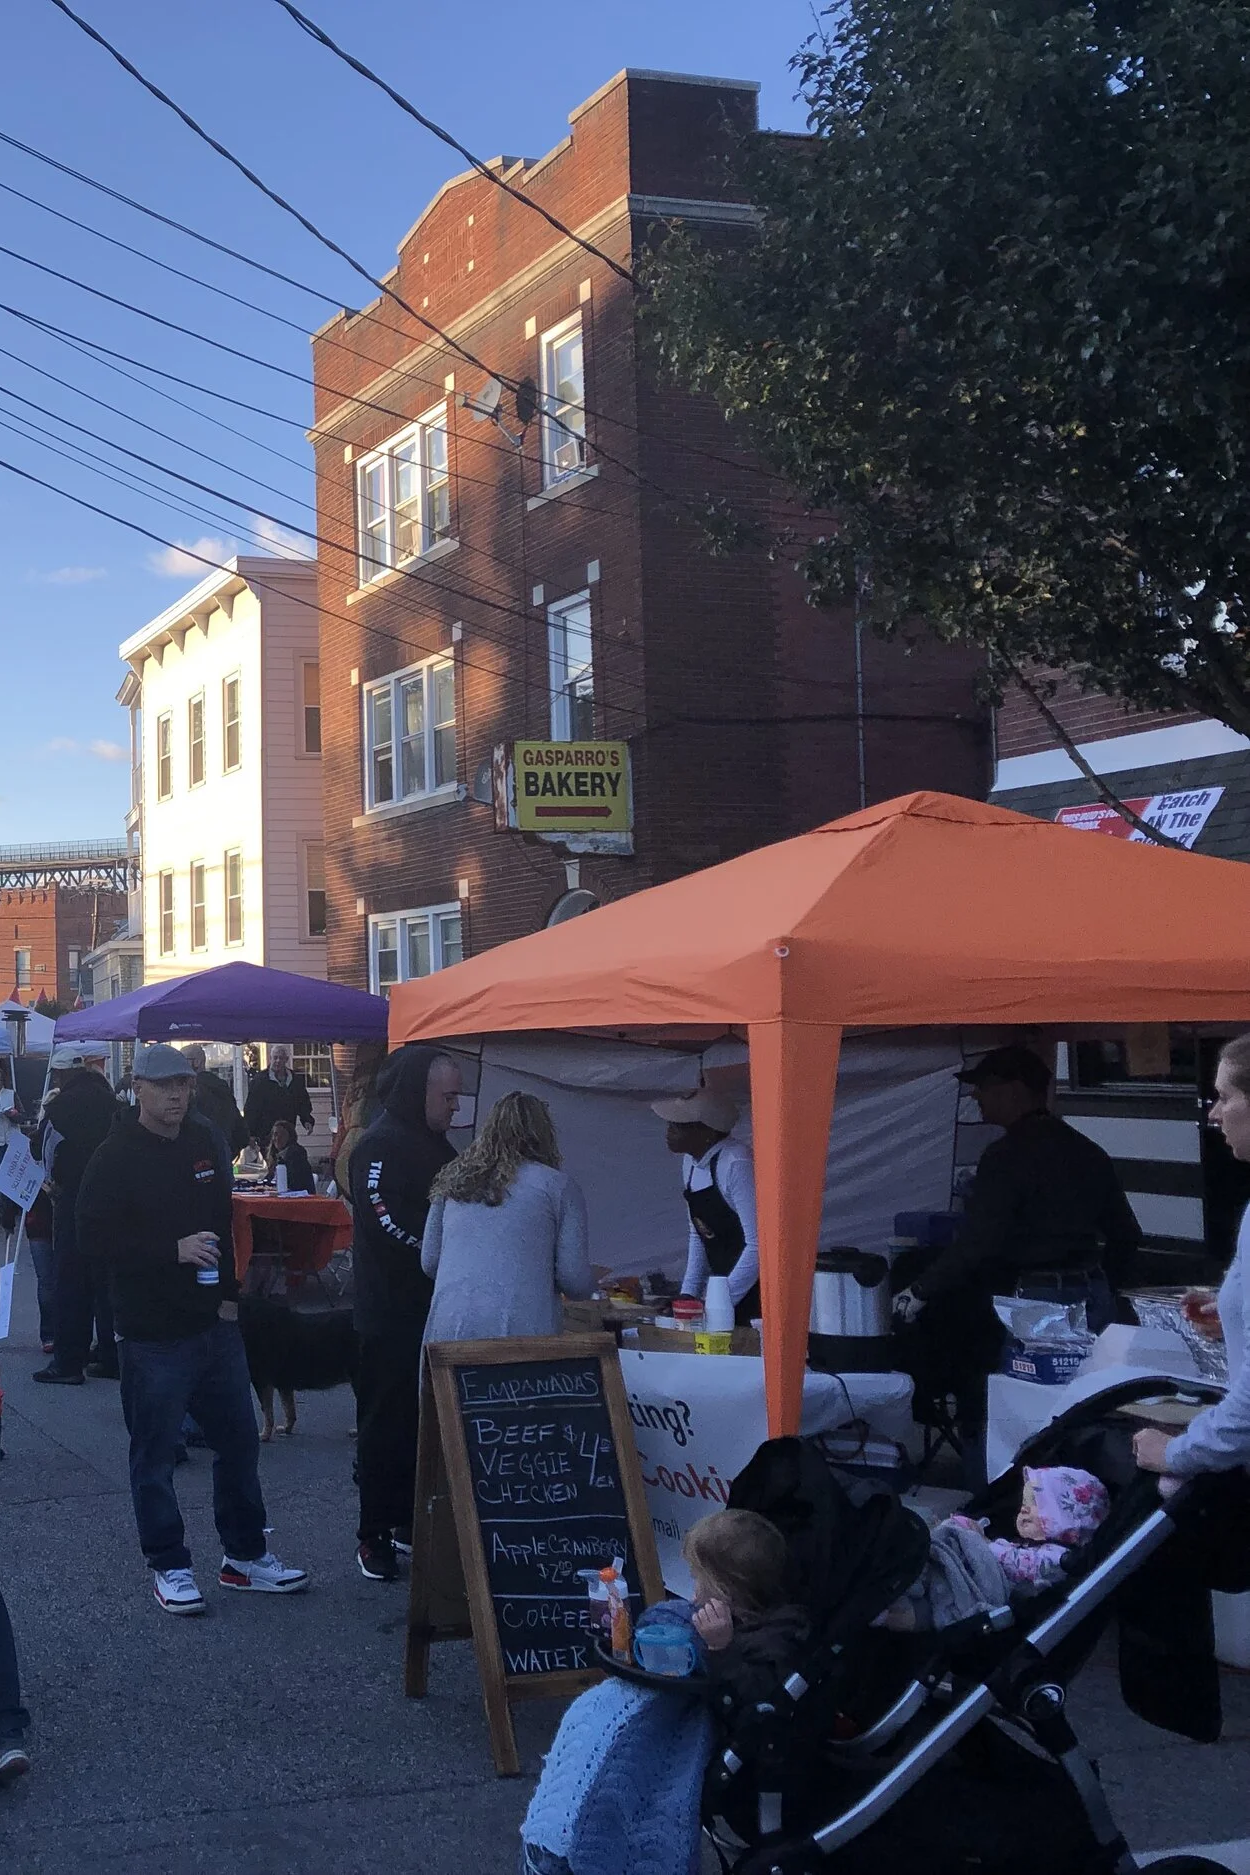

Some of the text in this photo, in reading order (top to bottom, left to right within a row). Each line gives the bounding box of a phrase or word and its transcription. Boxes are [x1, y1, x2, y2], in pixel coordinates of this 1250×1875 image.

[523, 749, 620, 766] GASPARRO'S
[524, 772, 622, 796] BAKERY
[1157, 791, 1211, 811] Catch
[1169, 811, 1203, 829] The
[367, 1161, 383, 1189] THE
[1014, 1360, 1035, 1373] 51215
[1052, 1357, 1080, 1367] 51215
[461, 1371, 599, 1405] EMPANADAS
[471, 1419, 556, 1444] BEEF
[478, 1448, 572, 1480] VEGGIE
[477, 1479, 578, 1504] CHICKEN
[506, 1645, 588, 1673] WATER
